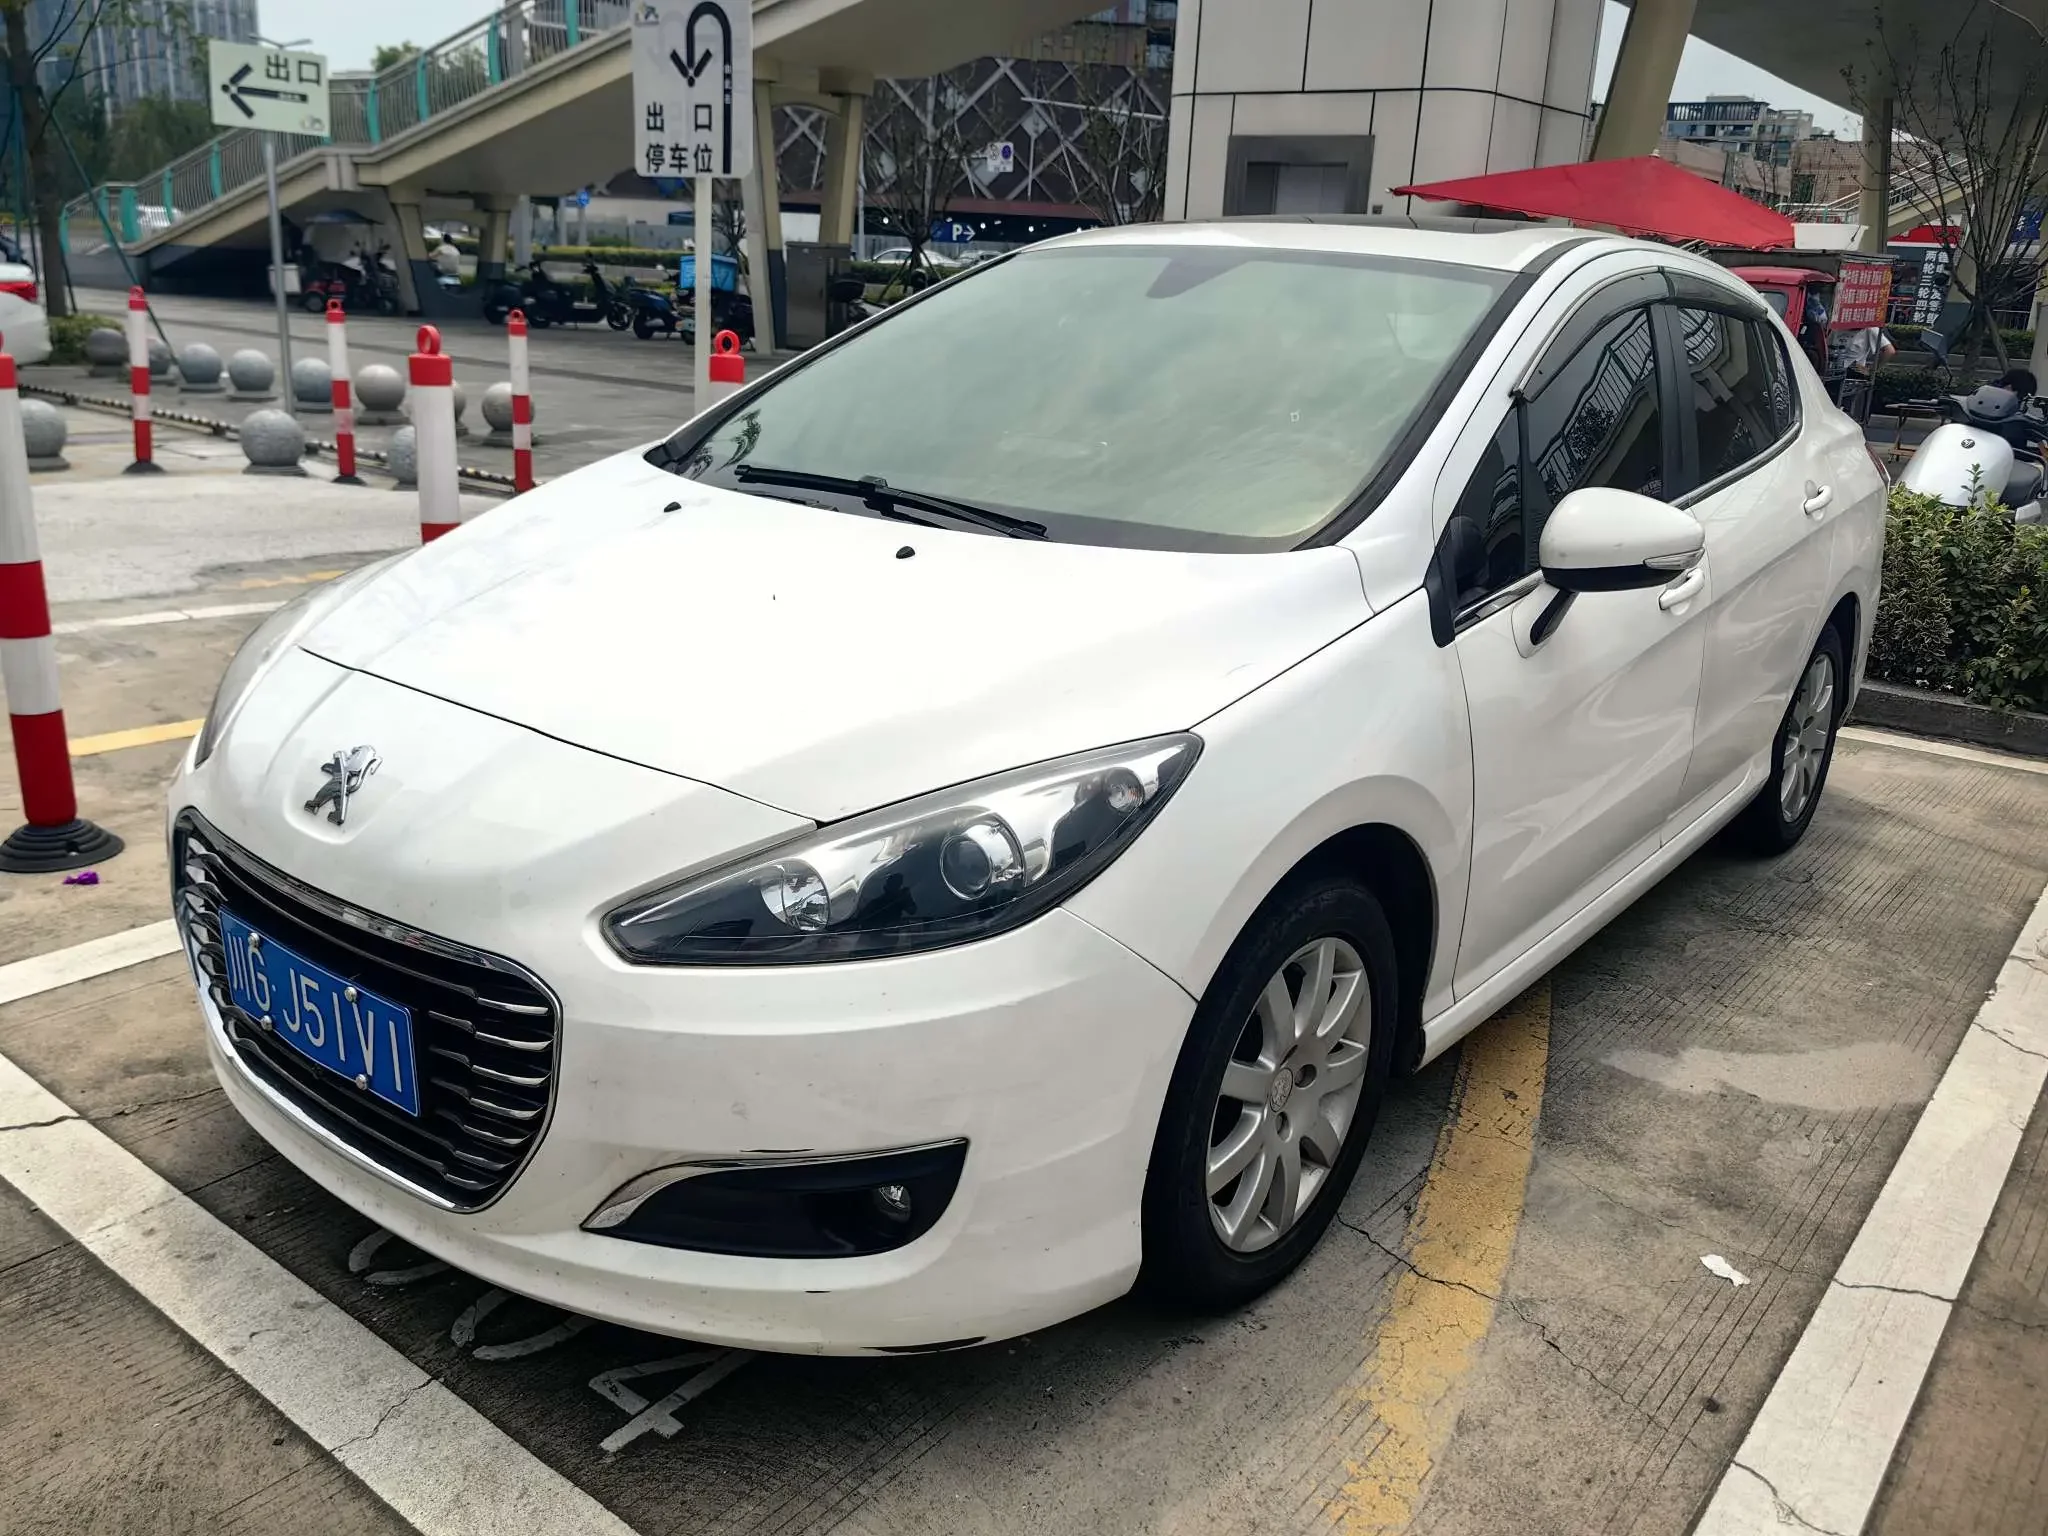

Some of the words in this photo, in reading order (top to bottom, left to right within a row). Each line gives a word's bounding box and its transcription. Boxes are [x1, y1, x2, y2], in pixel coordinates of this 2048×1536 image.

[266, 53, 320, 86] 出口
[646, 102, 712, 132] 出口
[646, 143, 713, 173] 停车位
[952, 223, 963, 241] P
[1913, 250, 1938, 323] 两轮三轮四轮
